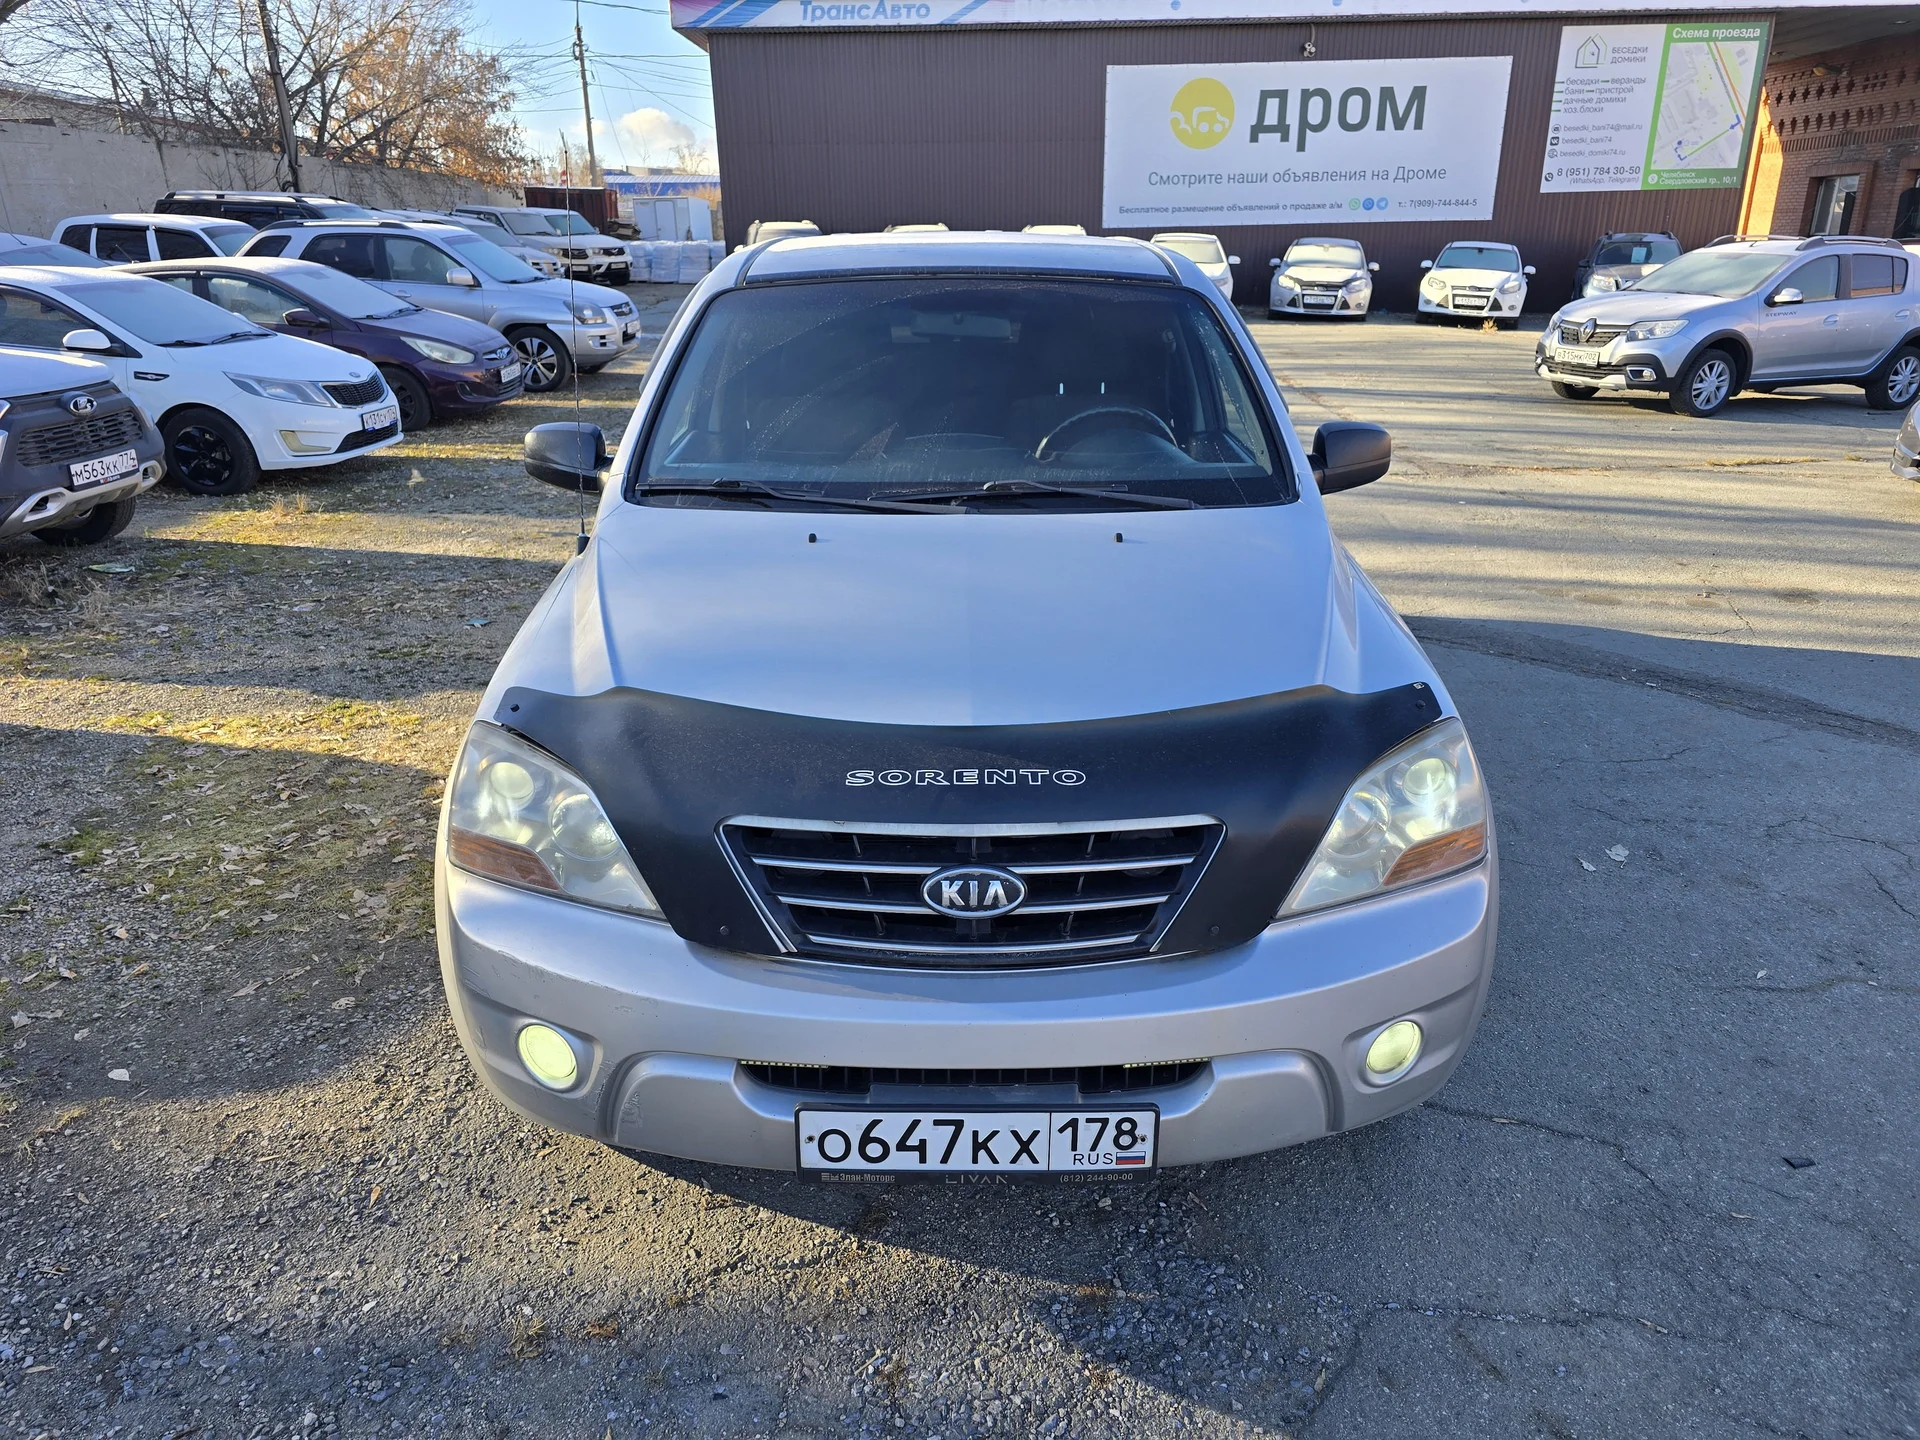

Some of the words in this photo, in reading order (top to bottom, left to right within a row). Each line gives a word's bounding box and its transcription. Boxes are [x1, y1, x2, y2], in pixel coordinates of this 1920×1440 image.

[801, 0, 931, 22] ТрансАвто
[1672, 27, 1709, 39] Схема
[1712, 27, 1761, 40] проезда
[1611, 46, 1648, 54] БЕСЕДКИ
[1610, 56, 1646, 64] ДОМИКИ
[1565, 77, 1600, 86] беседки
[1610, 77, 1646, 86] веранды
[1564, 87, 1585, 95] бани
[1595, 86, 1634, 95] пристрой
[1563, 97, 1594, 105] дачные
[1595, 97, 1627, 105] домики
[1563, 123, 1643, 133] besedki_bani74@mail.ru
[1561, 136, 1612, 145] besedki_bani74
[1560, 148, 1626, 158] besedki_domiki74.ru
[1148, 171, 1224, 188] Смотрите
[1227, 171, 1269, 185] наши
[1272, 167, 1367, 184] объявления
[1371, 169, 1390, 182] на
[1393, 166, 1447, 183] Дроме
[1557, 167, 1564, 176] 8
[1566, 167, 1591, 178] (951)
[1593, 167, 1611, 176] 784
[1613, 166, 1641, 175] 30-50
[1608, 176, 1640, 185] Telegram)
[1660, 177, 1707, 186] Свердловский
[1722, 176, 1737, 184] 10/1
[1119, 205, 1169, 214] Бесплатное
[1171, 205, 1224, 215] размещение
[1226, 203, 1280, 213] объявлений
[1290, 203, 1327, 212] продаже
[1329, 201, 1343, 210] а/м
[1409, 199, 1478, 209] 7(909)-744-844-5
[1765, 310, 1798, 318] STEPWAY
[845, 769, 1086, 786] SORENTO
[940, 880, 1009, 907] KIA
[1057, 1117, 1139, 1152] 178
[1072, 1152, 1114, 1166] RUS
[1060, 1174, 1084, 1183] (812)
[1087, 1173, 1133, 1182] 244-90-00
